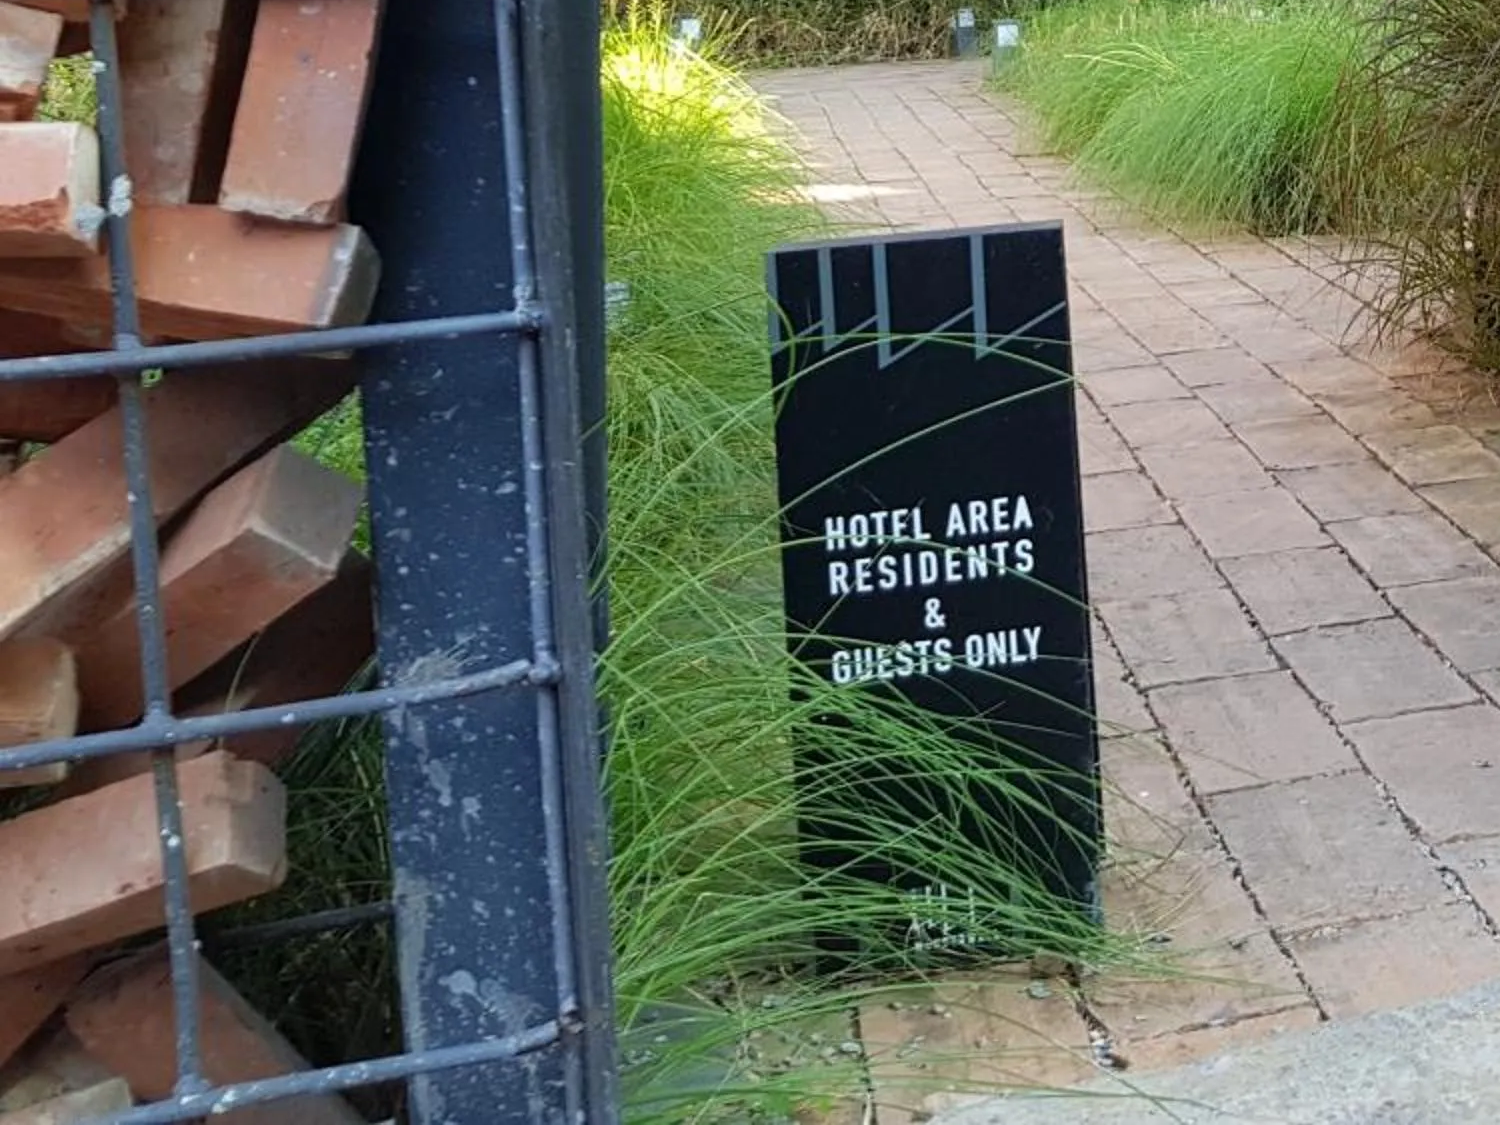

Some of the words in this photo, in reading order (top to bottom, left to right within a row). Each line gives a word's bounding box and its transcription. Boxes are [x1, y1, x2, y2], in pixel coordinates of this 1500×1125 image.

[824, 507, 931, 551] HOTEL
[945, 495, 1033, 538] AREA
[829, 539, 1034, 595] RESIDENTS
[924, 597, 947, 628] &
[832, 638, 953, 684] GUESTS
[965, 626, 1042, 668] ONLY
